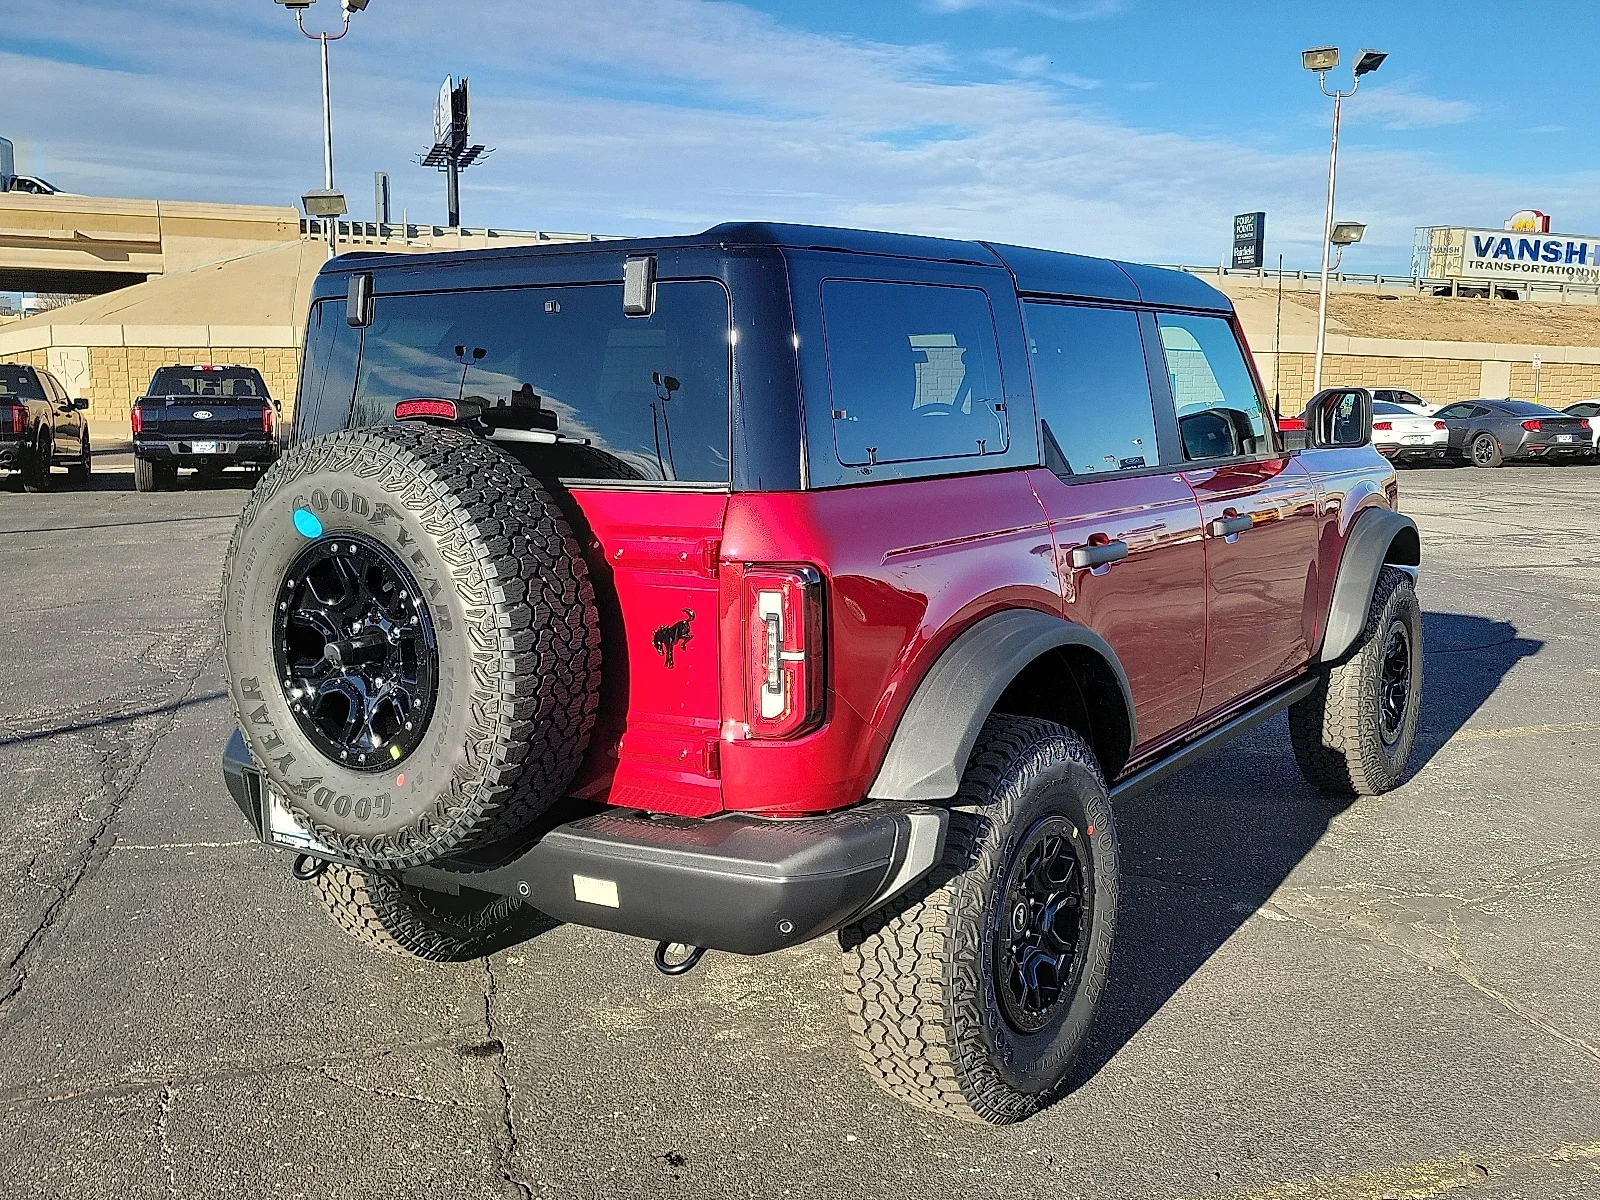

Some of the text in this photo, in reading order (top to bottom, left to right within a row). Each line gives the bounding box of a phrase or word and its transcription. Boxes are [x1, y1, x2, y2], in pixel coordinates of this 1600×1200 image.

[1434, 246, 1460, 254] VANSH
[1473, 235, 1588, 264] VANSH
[1468, 260, 1584, 277] TRANSPORTATION
